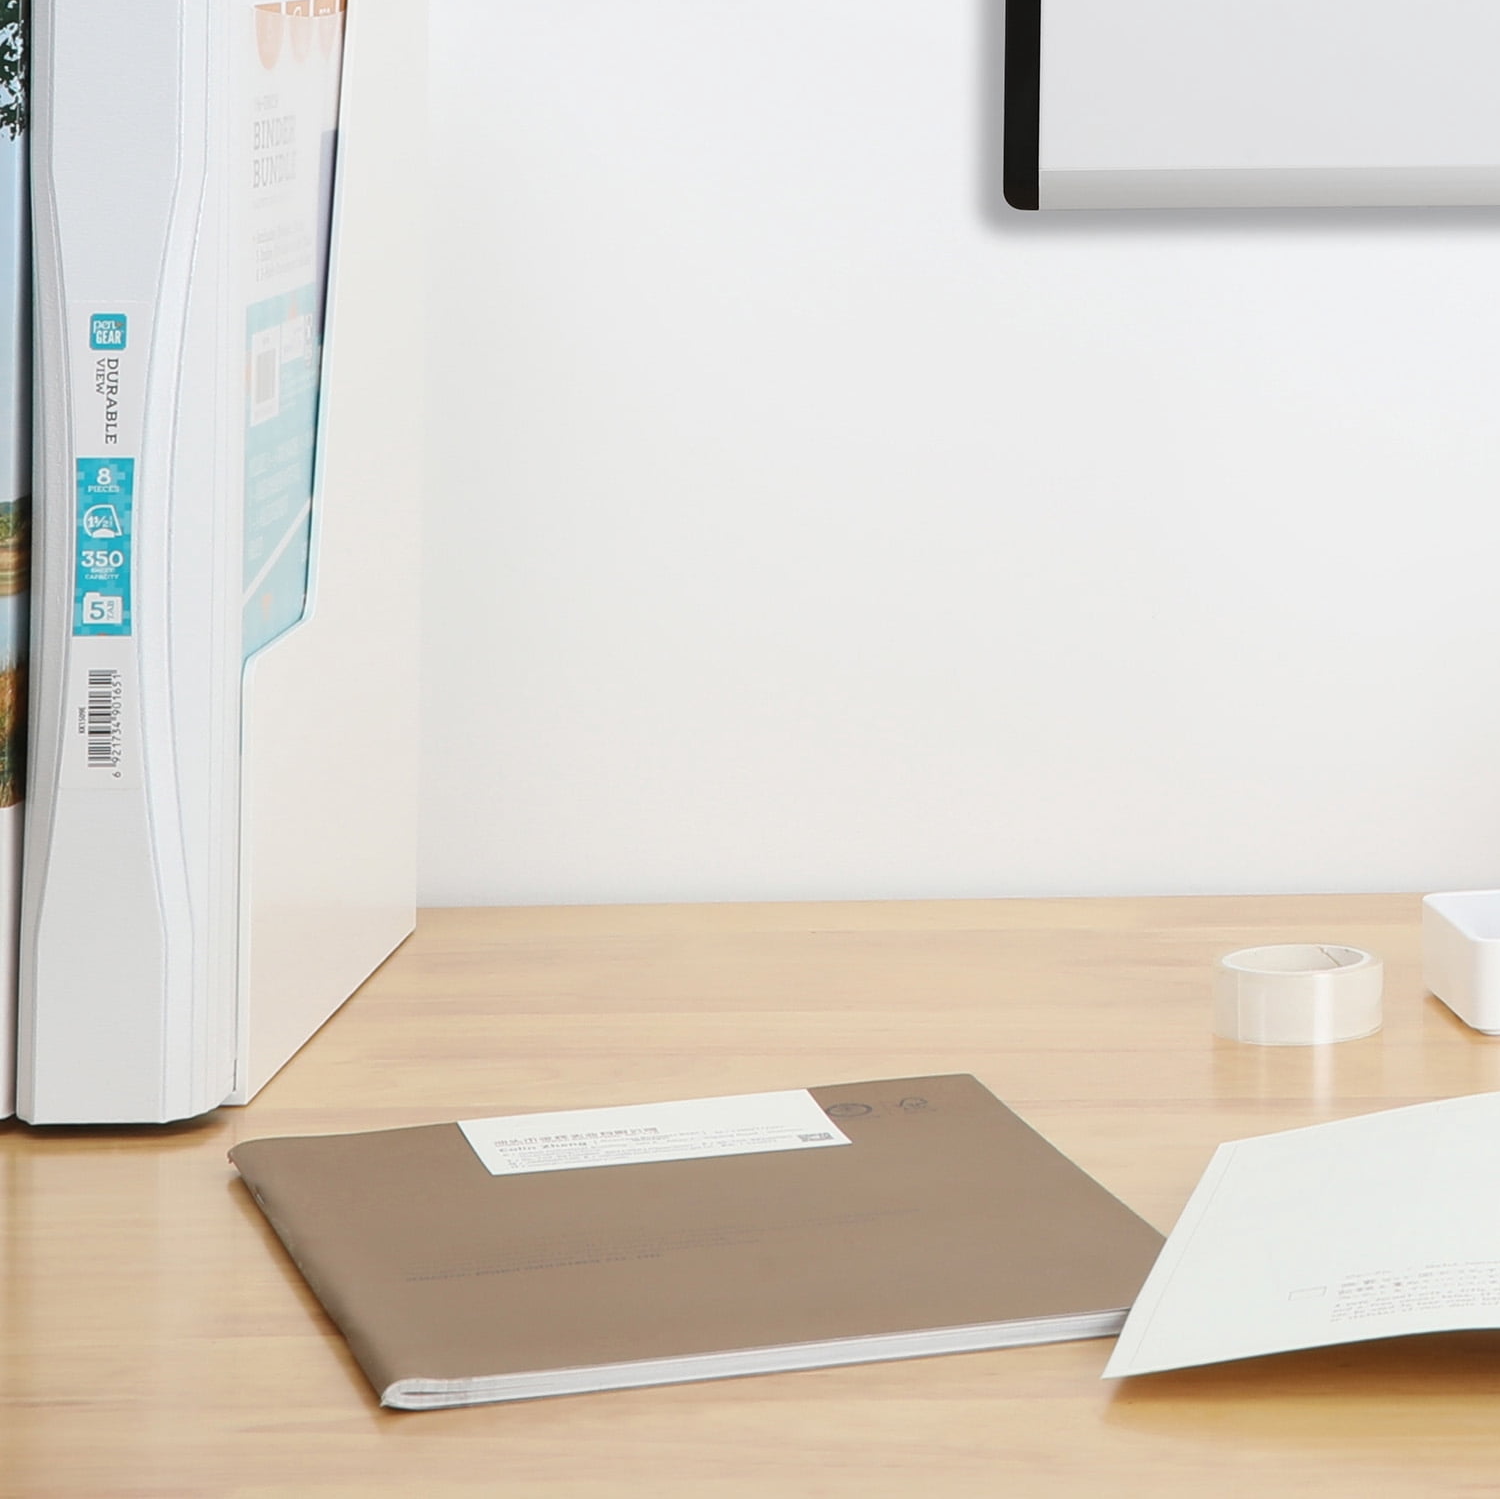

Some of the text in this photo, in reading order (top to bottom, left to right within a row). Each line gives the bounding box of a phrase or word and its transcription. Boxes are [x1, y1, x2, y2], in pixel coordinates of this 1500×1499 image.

[95, 330, 122, 345] GEAR
[95, 357, 105, 394] VIEW
[105, 357, 119, 445] DURABLE
[96, 467, 111, 485] 8
[81, 550, 124, 568] 350
[90, 601, 105, 620] 5
